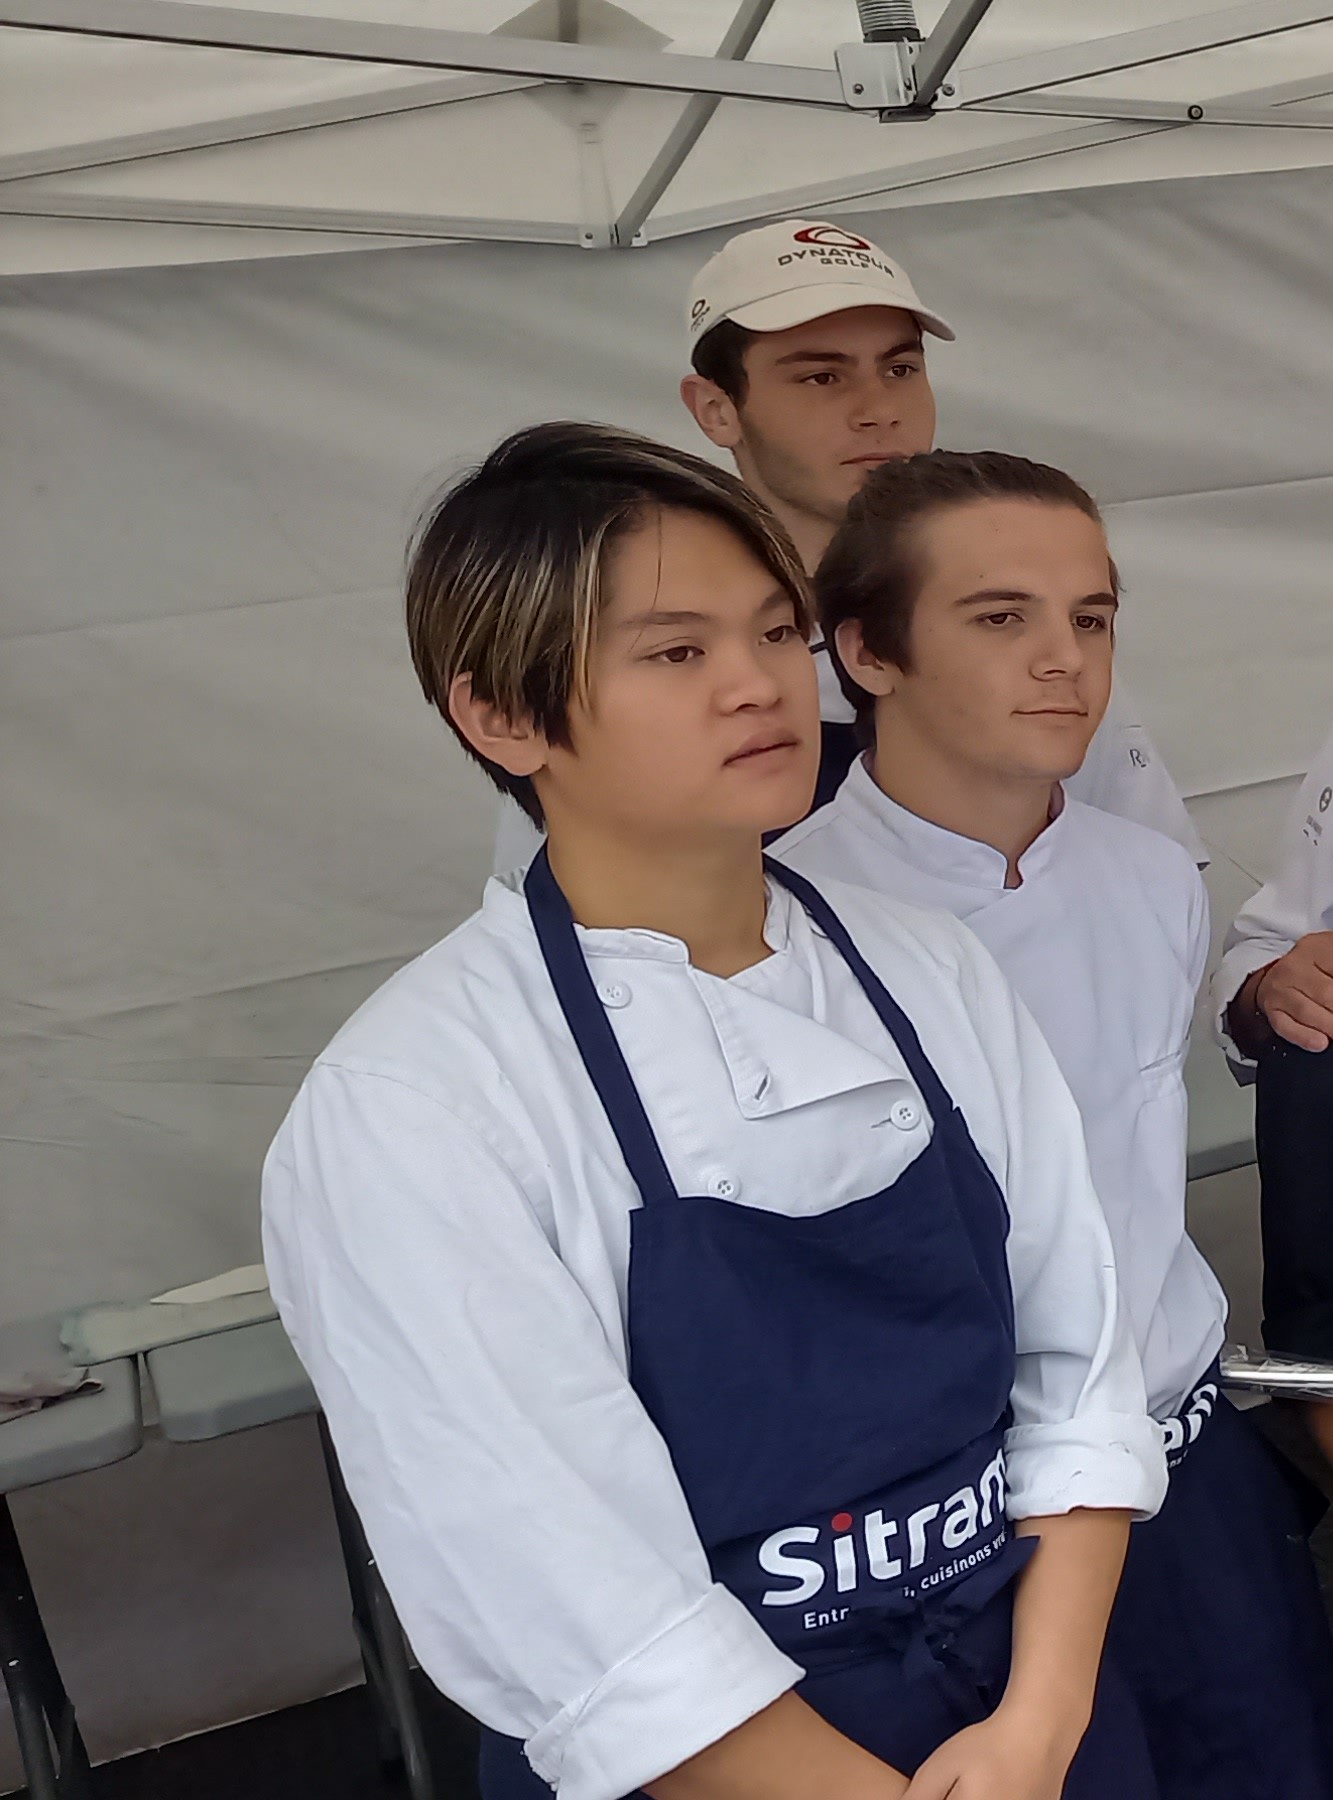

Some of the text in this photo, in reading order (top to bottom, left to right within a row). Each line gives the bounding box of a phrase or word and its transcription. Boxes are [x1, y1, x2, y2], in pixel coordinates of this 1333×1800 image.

[777, 247, 895, 279] DYNATOUR
[820, 257, 869, 269] GOLF
[803, 1543, 992, 1629] Entr cuisinons
